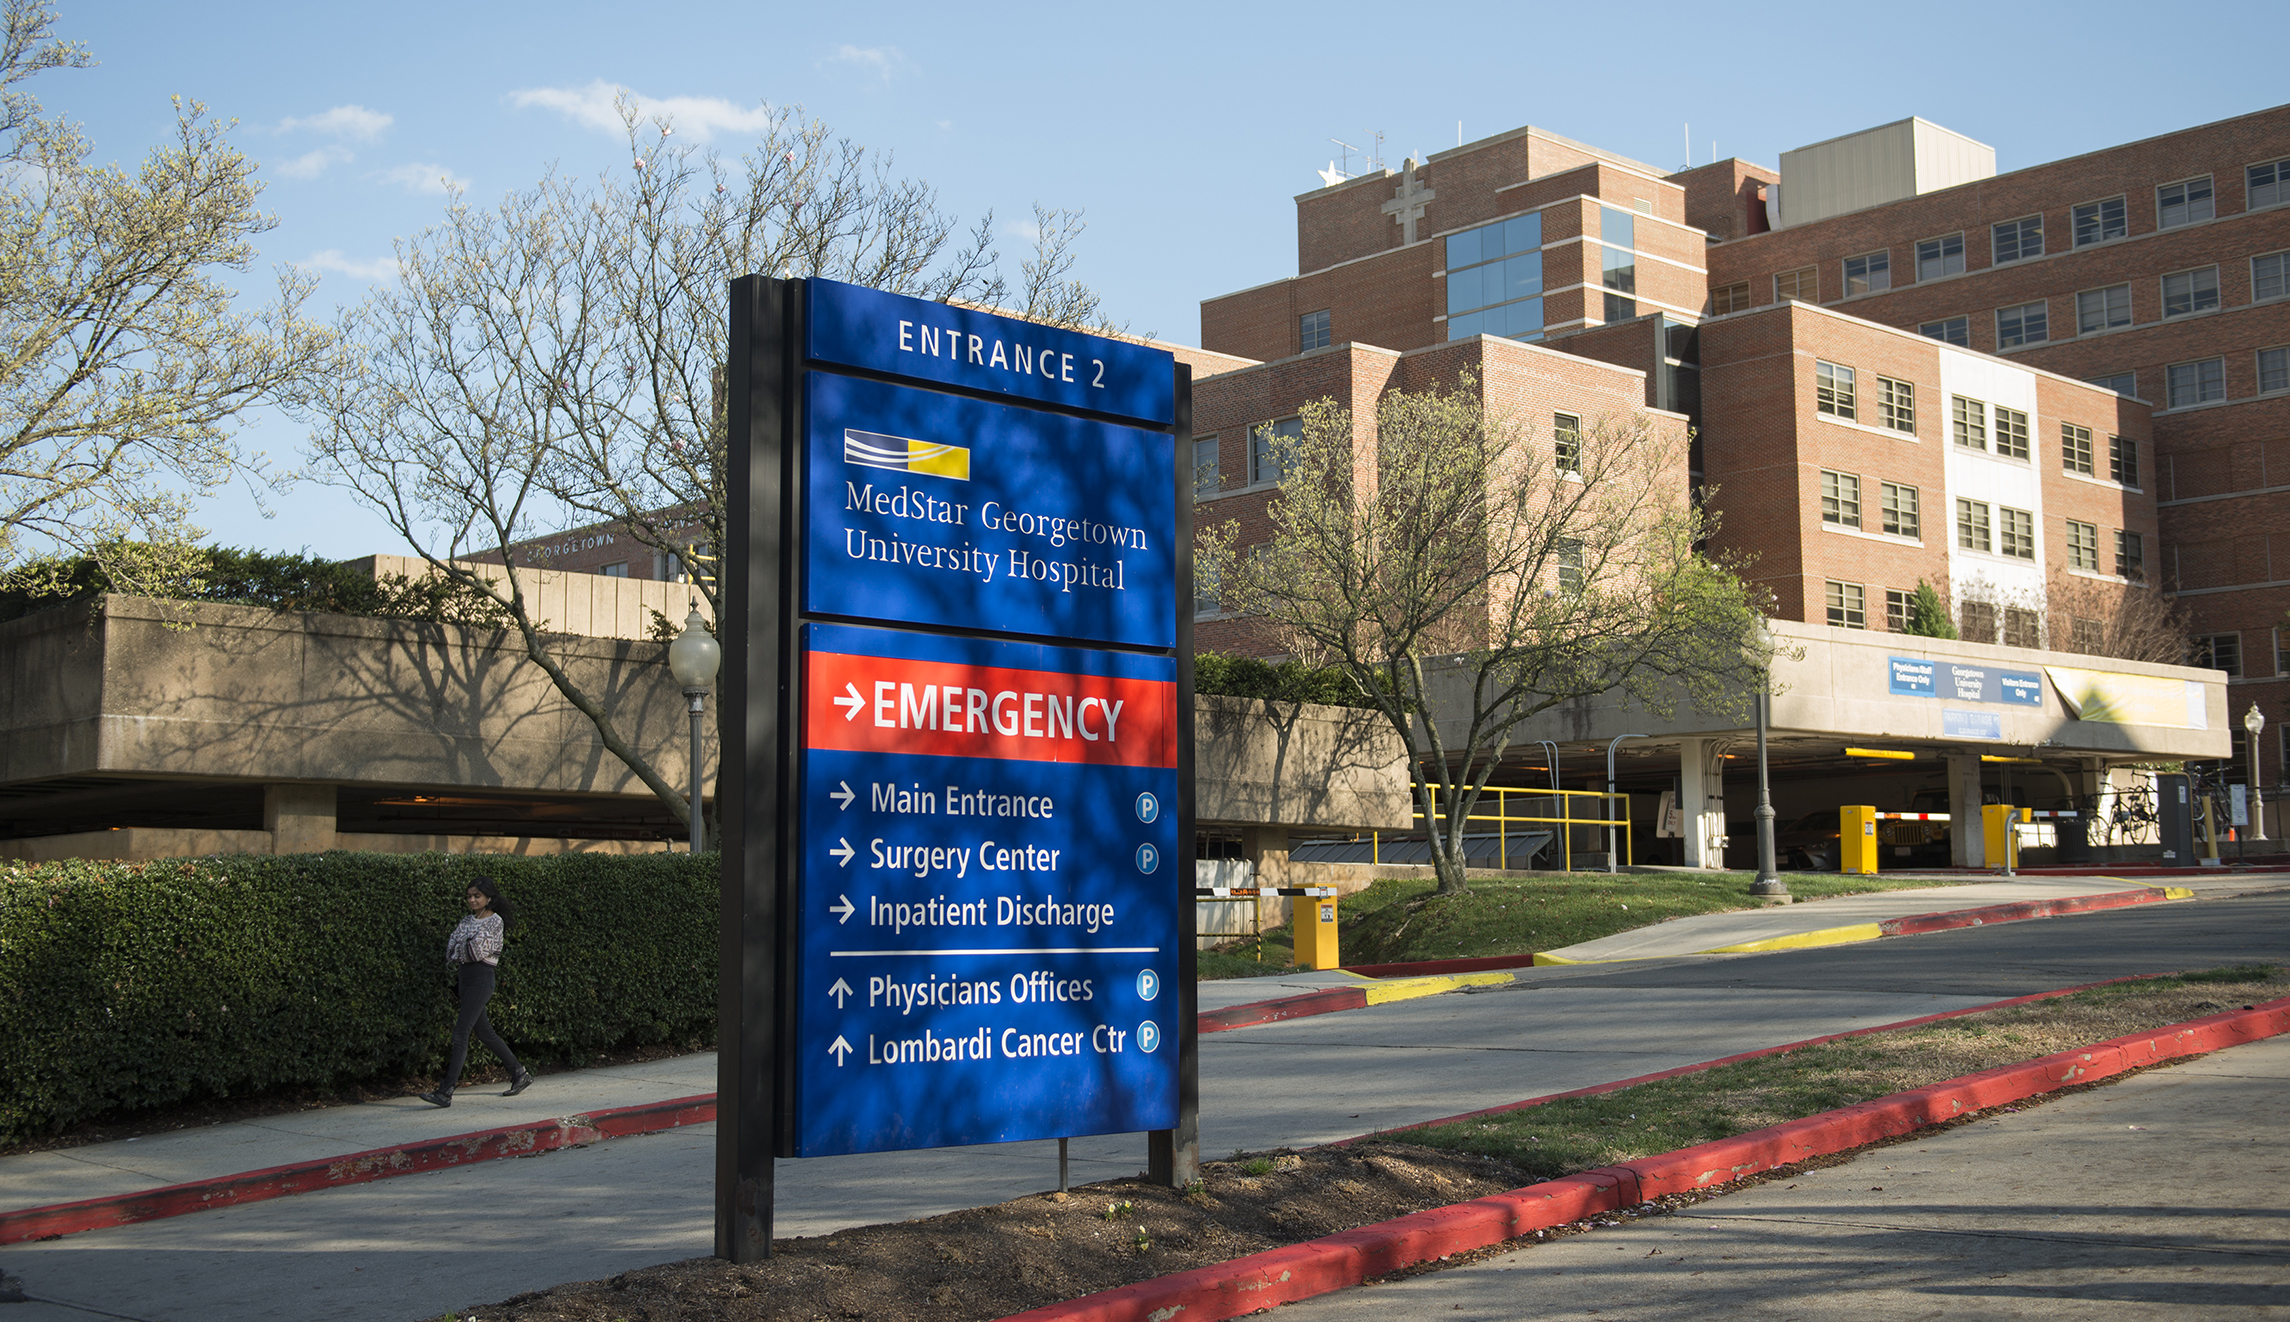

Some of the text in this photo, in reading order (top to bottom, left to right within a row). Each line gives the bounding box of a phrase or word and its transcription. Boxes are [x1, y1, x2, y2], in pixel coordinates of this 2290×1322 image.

[900, 319, 1105, 388] ENTRANCE 2
[844, 480, 1147, 550] MedStar Georgetown
[844, 528, 1124, 593] University Hospital
[1896, 673, 1930, 686] Entrance Only
[1952, 665, 1984, 679] Georgetown
[1954, 677, 1983, 690] University
[2002, 677, 2039, 689] Visitors Entrance
[874, 681, 1124, 742] EMERGENCY
[1957, 687, 1981, 700] Hospital
[2015, 688, 2027, 698] Only
[873, 783, 936, 815] Main
[946, 786, 1054, 819] Entrance
[870, 838, 970, 879] Surgery
[979, 841, 1060, 872] Center
[871, 895, 1115, 935] Inpatient Discharge
[870, 974, 1001, 1015] Physicians
[1010, 971, 1093, 1003] Offices
[869, 1027, 992, 1065] Lombardi
[1001, 1028, 1084, 1059] Cancer
[1092, 1024, 1126, 1054] Ctr
